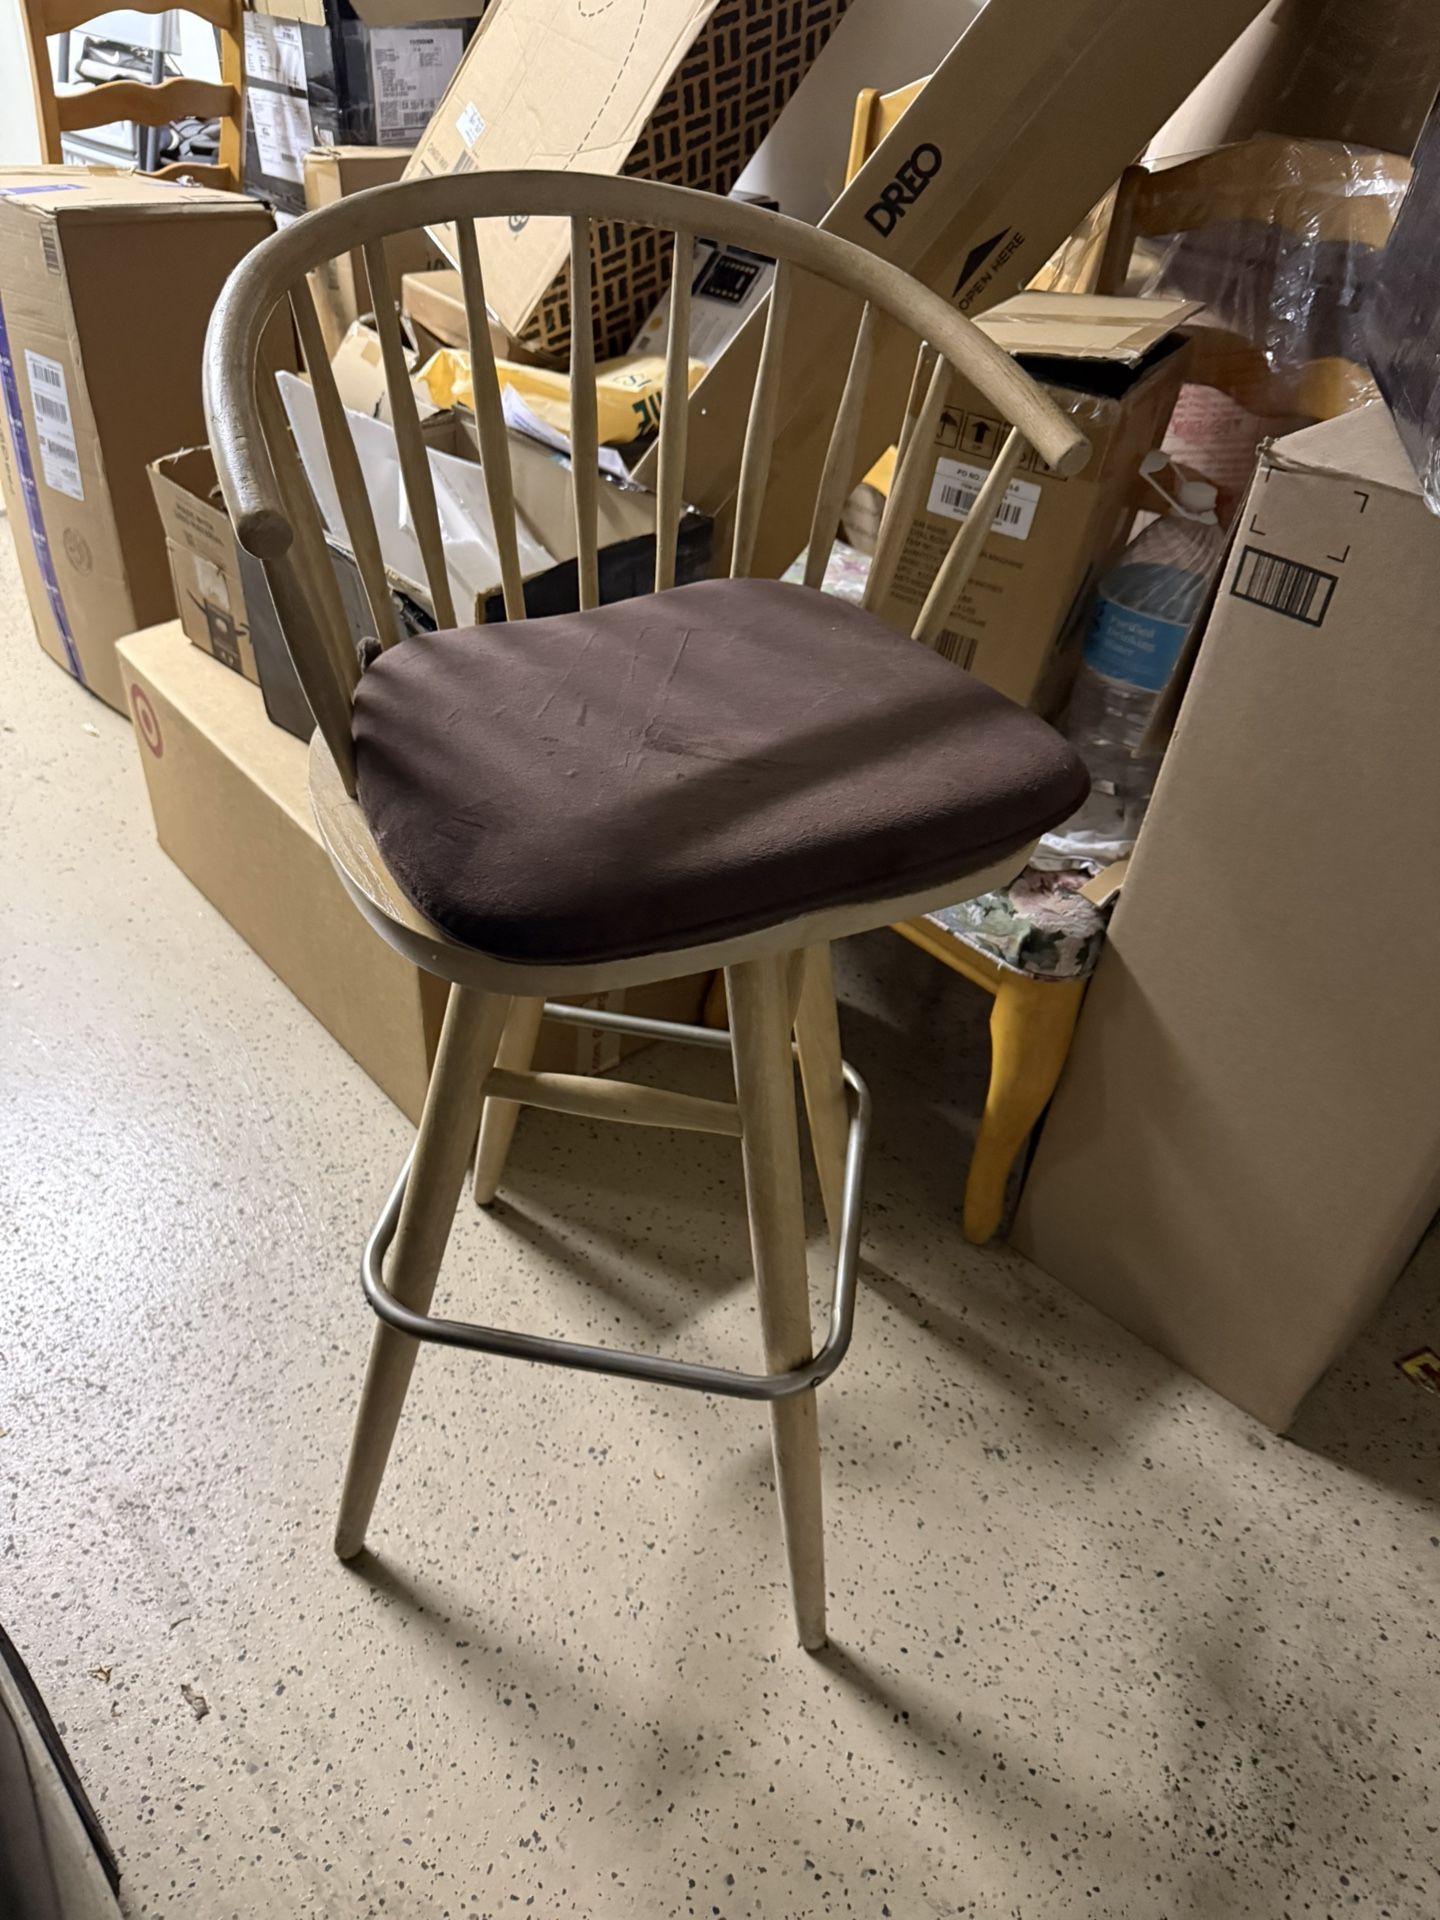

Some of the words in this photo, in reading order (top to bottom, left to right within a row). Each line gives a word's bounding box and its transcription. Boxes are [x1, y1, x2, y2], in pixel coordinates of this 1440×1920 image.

[864, 142, 943, 239] DREO
[958, 272, 993, 311] OPEN
[993, 231, 1026, 273] HERE
